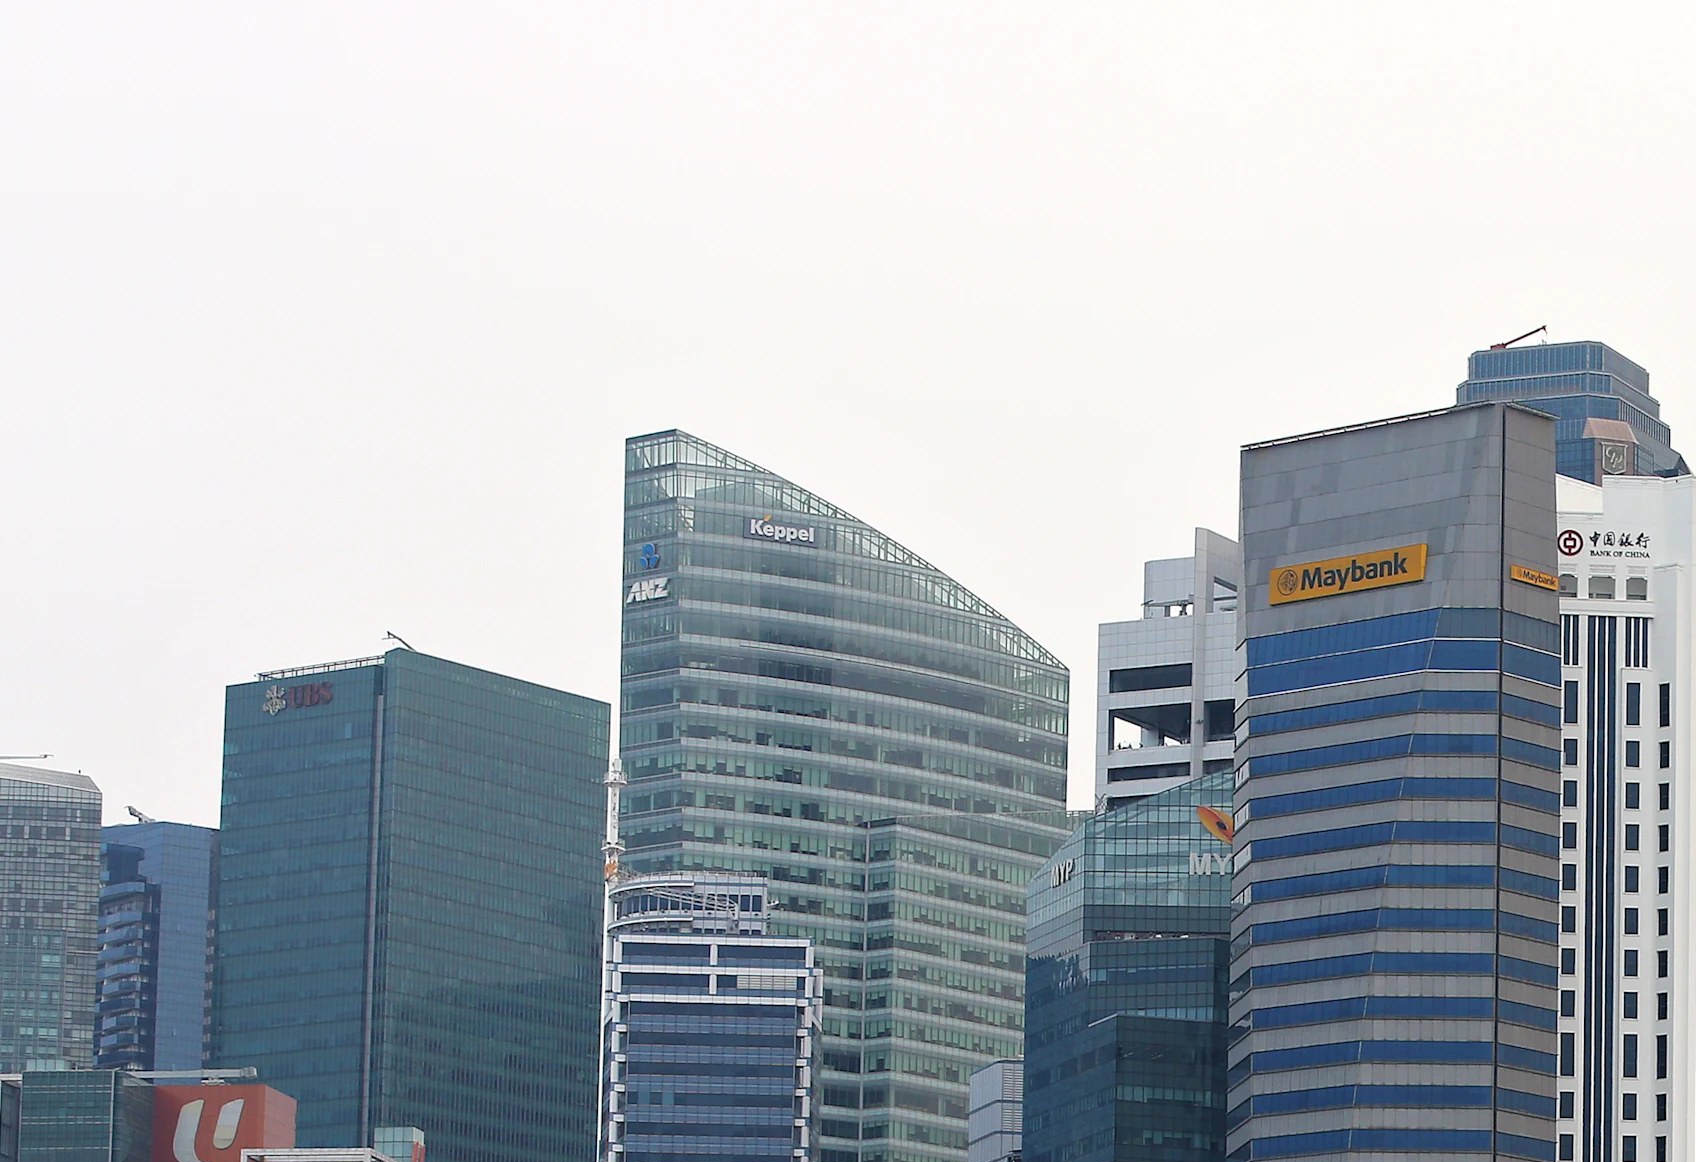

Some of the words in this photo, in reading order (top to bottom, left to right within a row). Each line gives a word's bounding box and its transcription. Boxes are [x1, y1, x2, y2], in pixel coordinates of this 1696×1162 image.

[750, 518, 815, 543] Keppel
[1301, 552, 1408, 590] Maybank
[1523, 569, 1556, 587] Maybank
[626, 577, 670, 604] ANZ
[290, 682, 333, 708] UBS
[1051, 858, 1076, 887] MYP
[1189, 853, 1233, 876] MY
